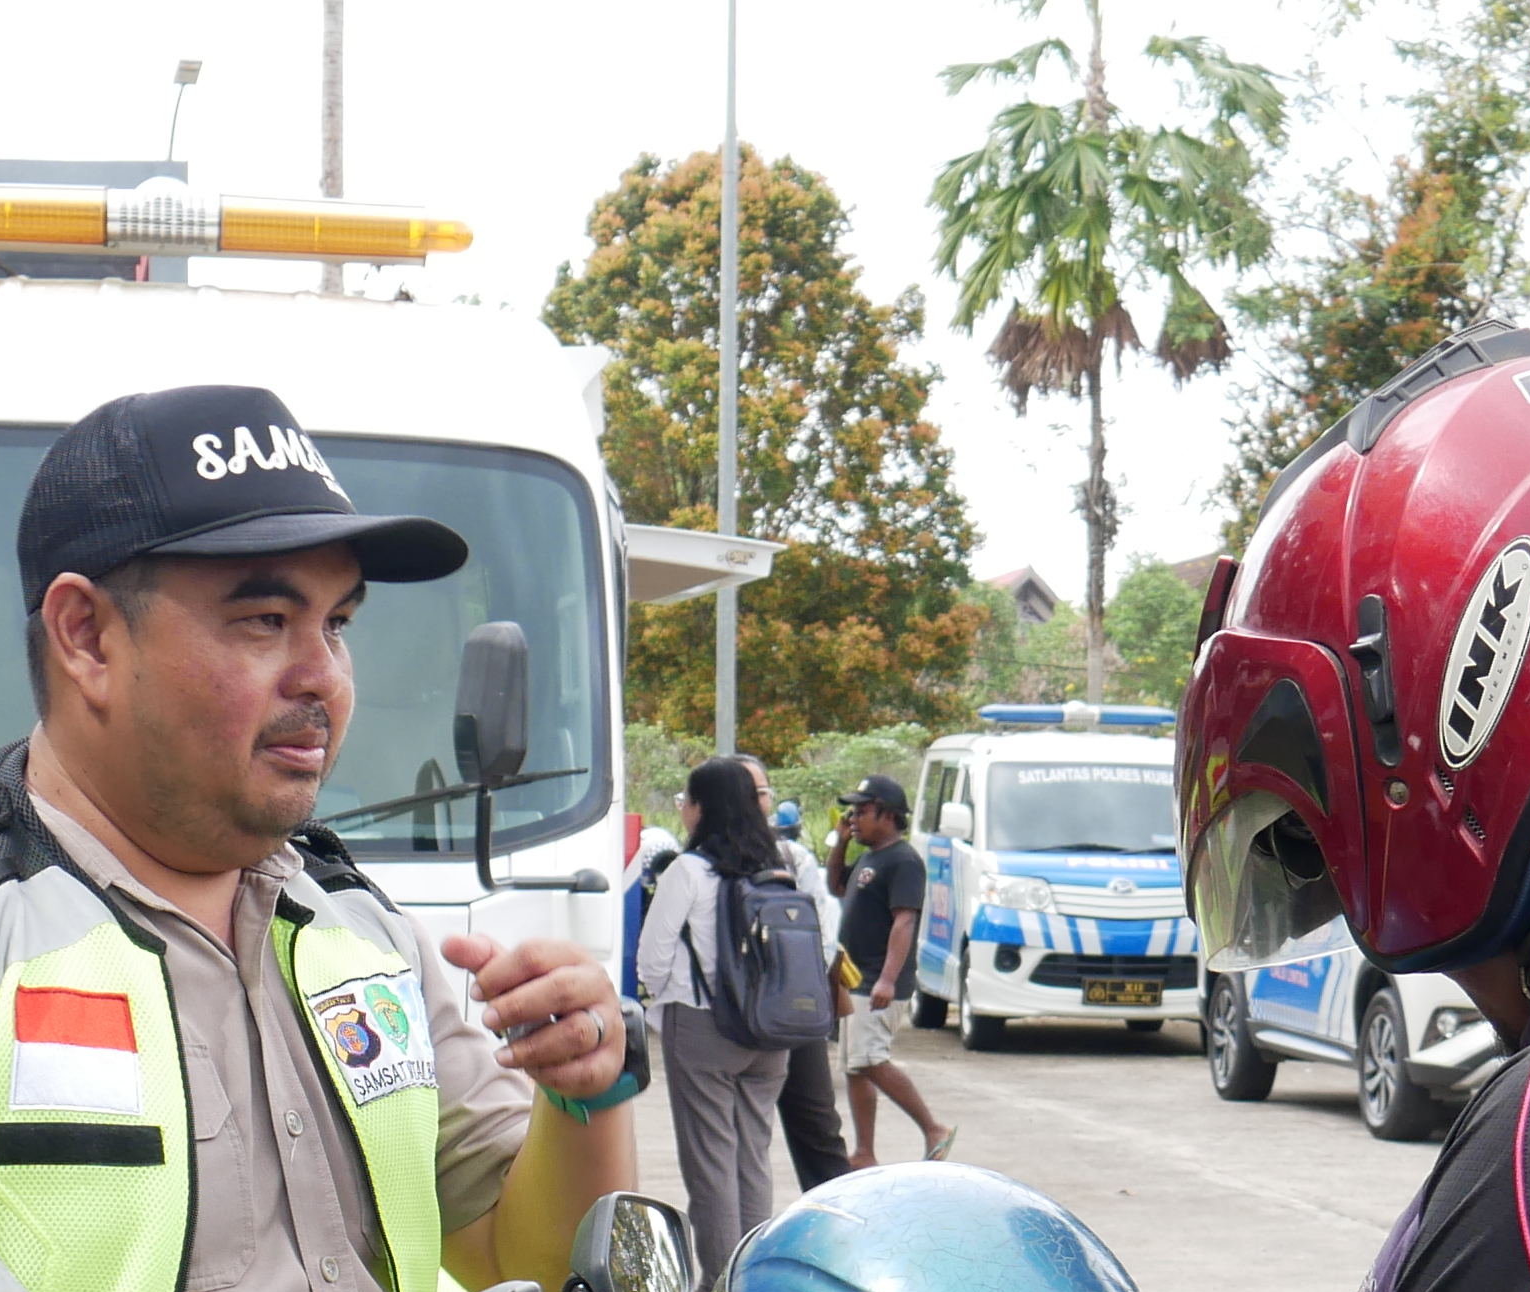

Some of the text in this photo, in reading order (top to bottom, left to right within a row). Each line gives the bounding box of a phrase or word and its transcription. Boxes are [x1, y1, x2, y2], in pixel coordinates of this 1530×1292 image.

[1447, 558, 1523, 746] INK
[1018, 767, 1090, 784] SATLANTAS
[1092, 767, 1141, 783] POLRES
[353, 1060, 408, 1096] SAMSAT
